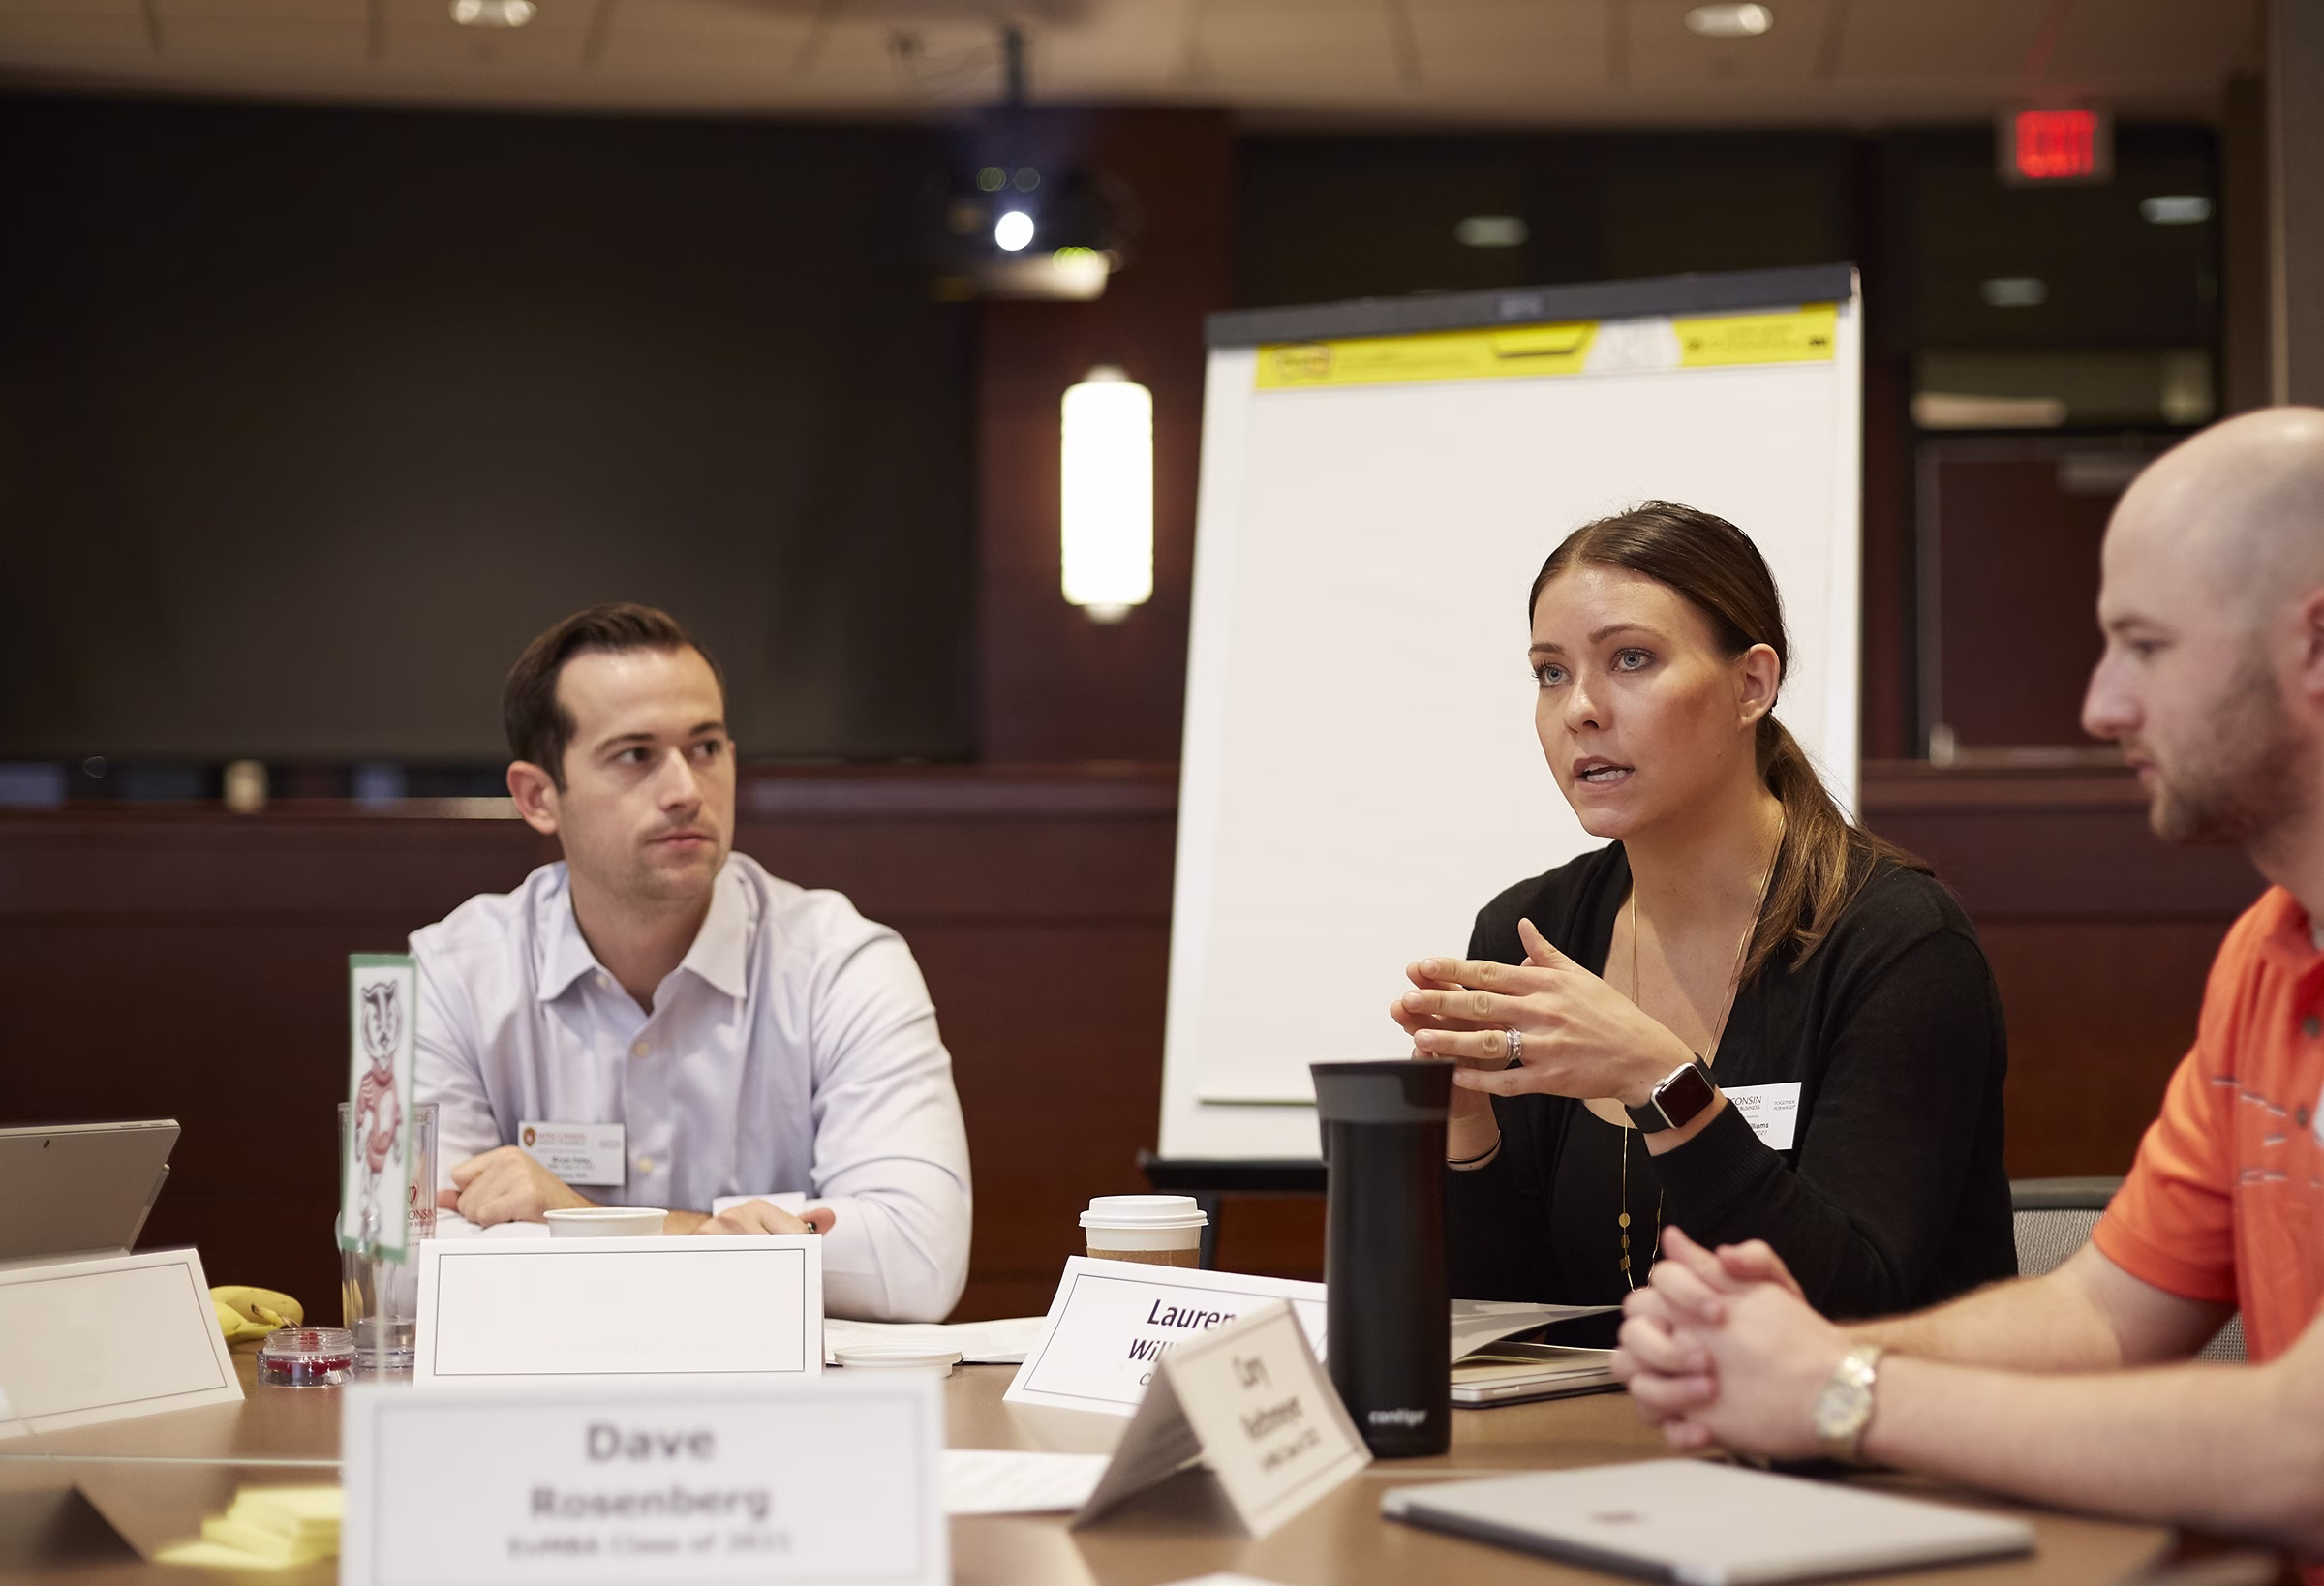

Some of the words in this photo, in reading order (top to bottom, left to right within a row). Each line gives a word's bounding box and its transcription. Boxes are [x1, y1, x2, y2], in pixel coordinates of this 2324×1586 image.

[587, 1422, 716, 1463] Dave
[529, 1479, 772, 1522] Rosenberg
[689, 1532, 716, 1553] of
